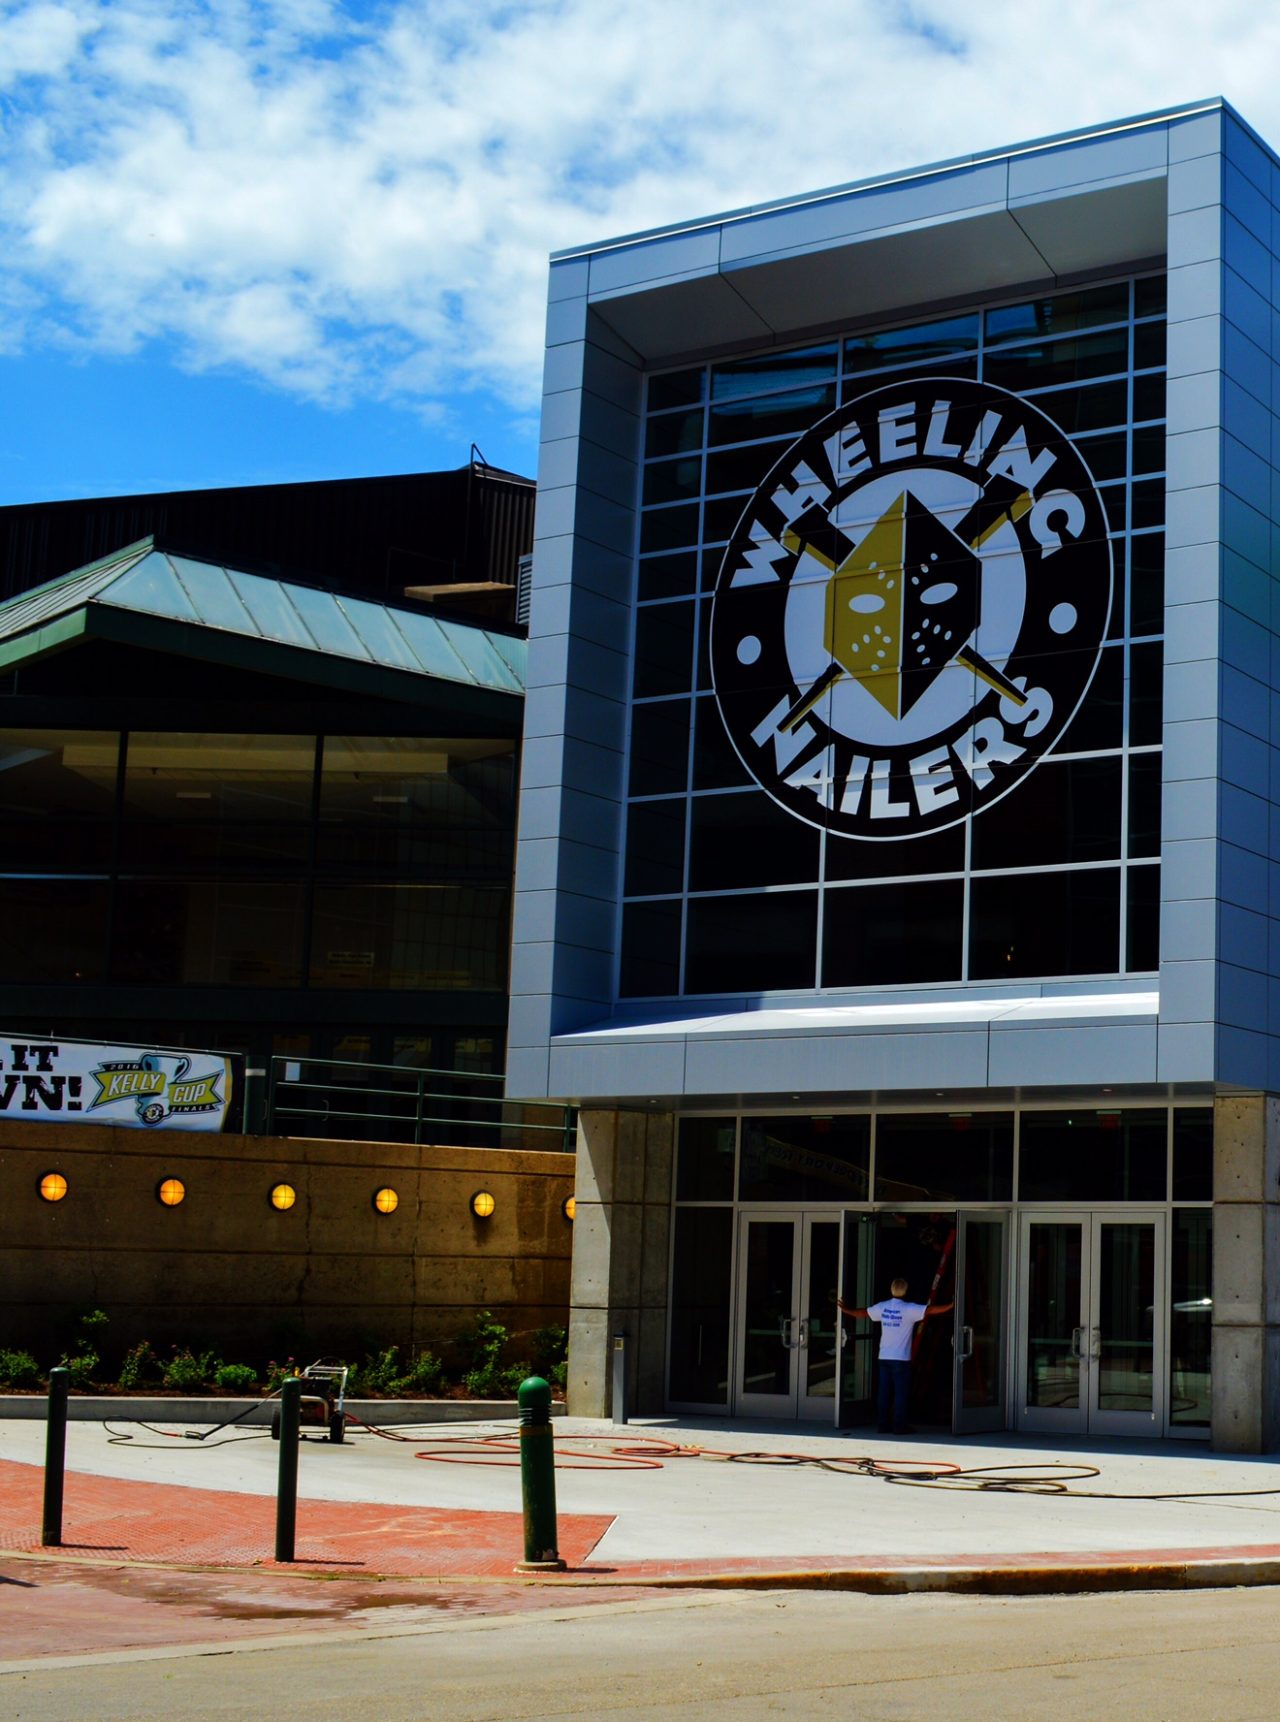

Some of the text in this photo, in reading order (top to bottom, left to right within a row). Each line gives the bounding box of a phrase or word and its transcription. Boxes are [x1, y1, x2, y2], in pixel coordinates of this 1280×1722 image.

[730, 399, 1086, 588] WHEELING
[750, 676, 1054, 820] NAILERS
[11, 1044, 59, 1072] IT
[109, 1063, 140, 1071] 2016
[108, 1072, 208, 1103] KELLY CUP
[171, 1104, 211, 1112] FINALS
